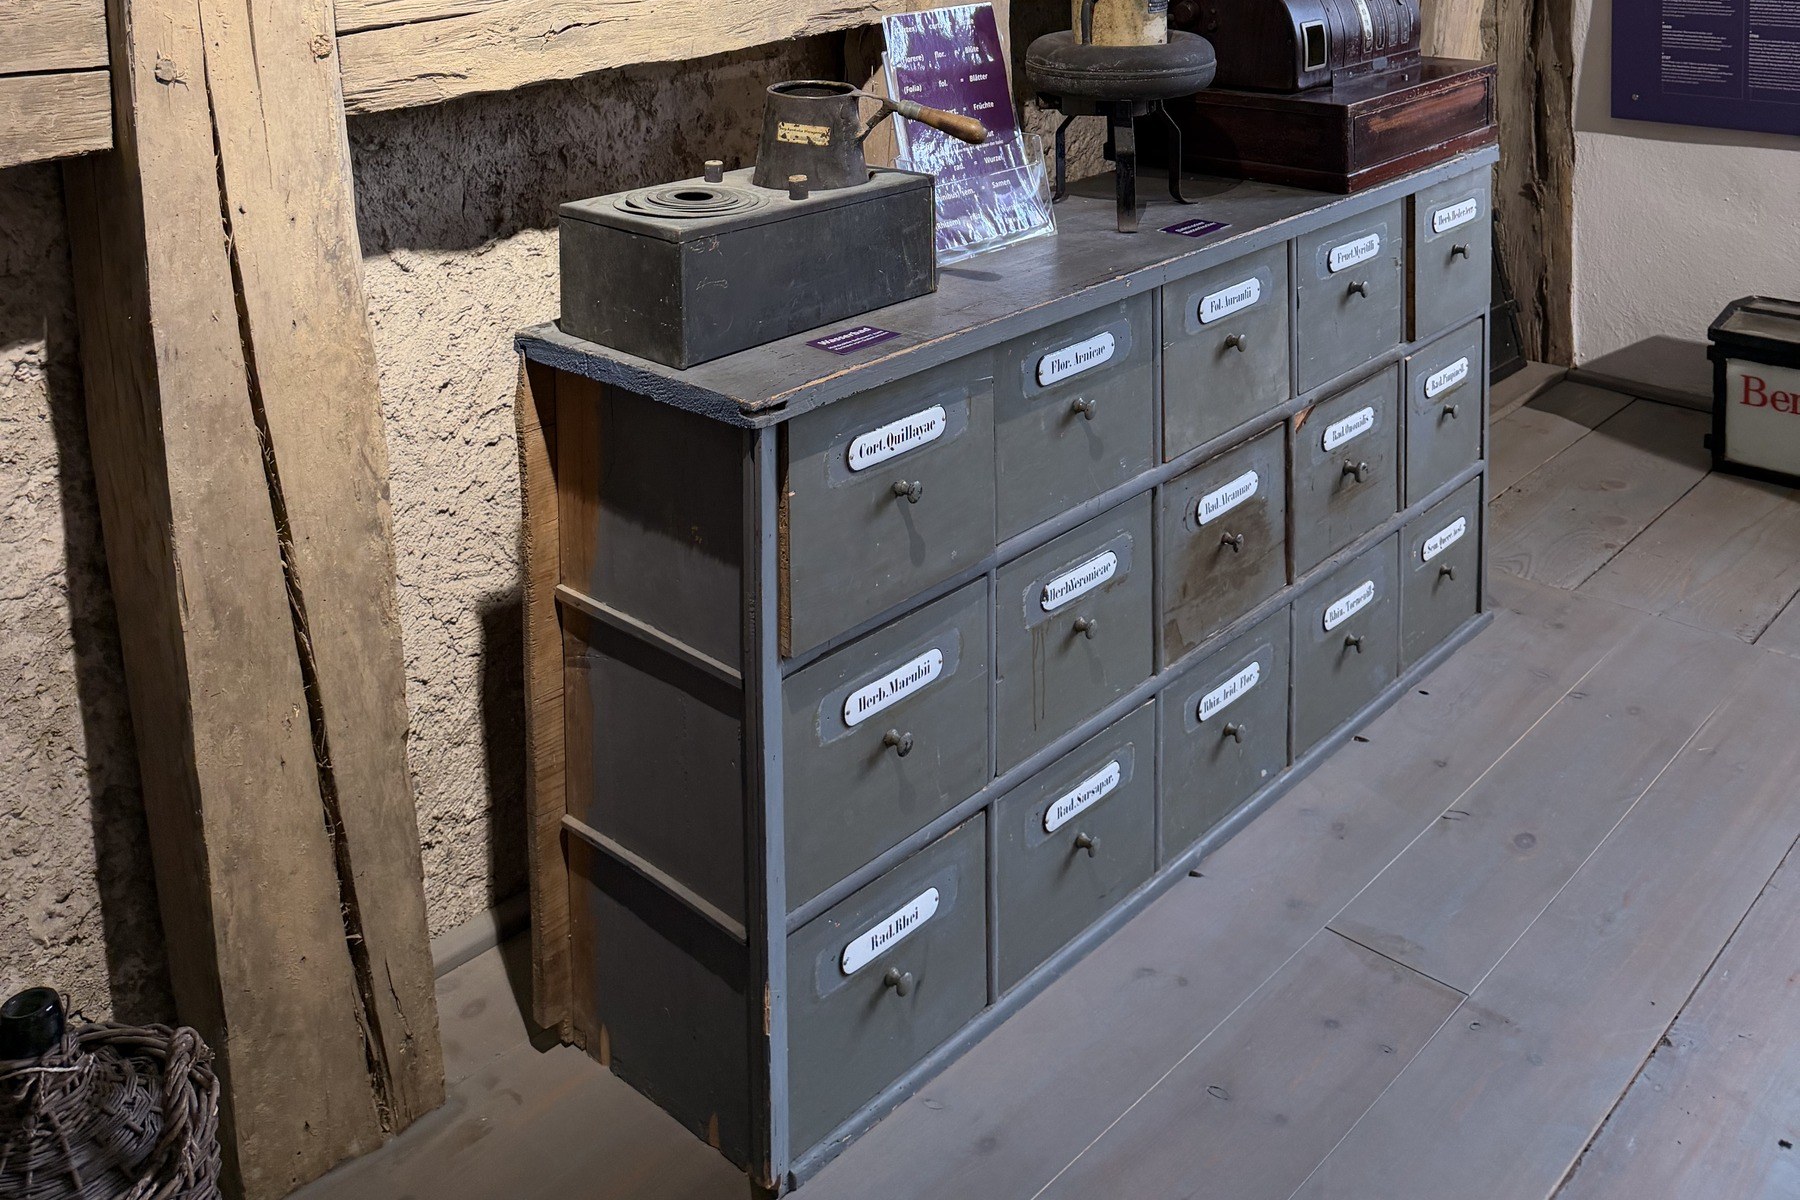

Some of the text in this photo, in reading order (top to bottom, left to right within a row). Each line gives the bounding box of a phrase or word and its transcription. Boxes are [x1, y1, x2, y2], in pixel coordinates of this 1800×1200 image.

[903, 85, 922, 94] (Folia)
[969, 73, 988, 82] Blätter
[973, 101, 994, 111] Früchte
[992, 179, 1010, 188] Samen
